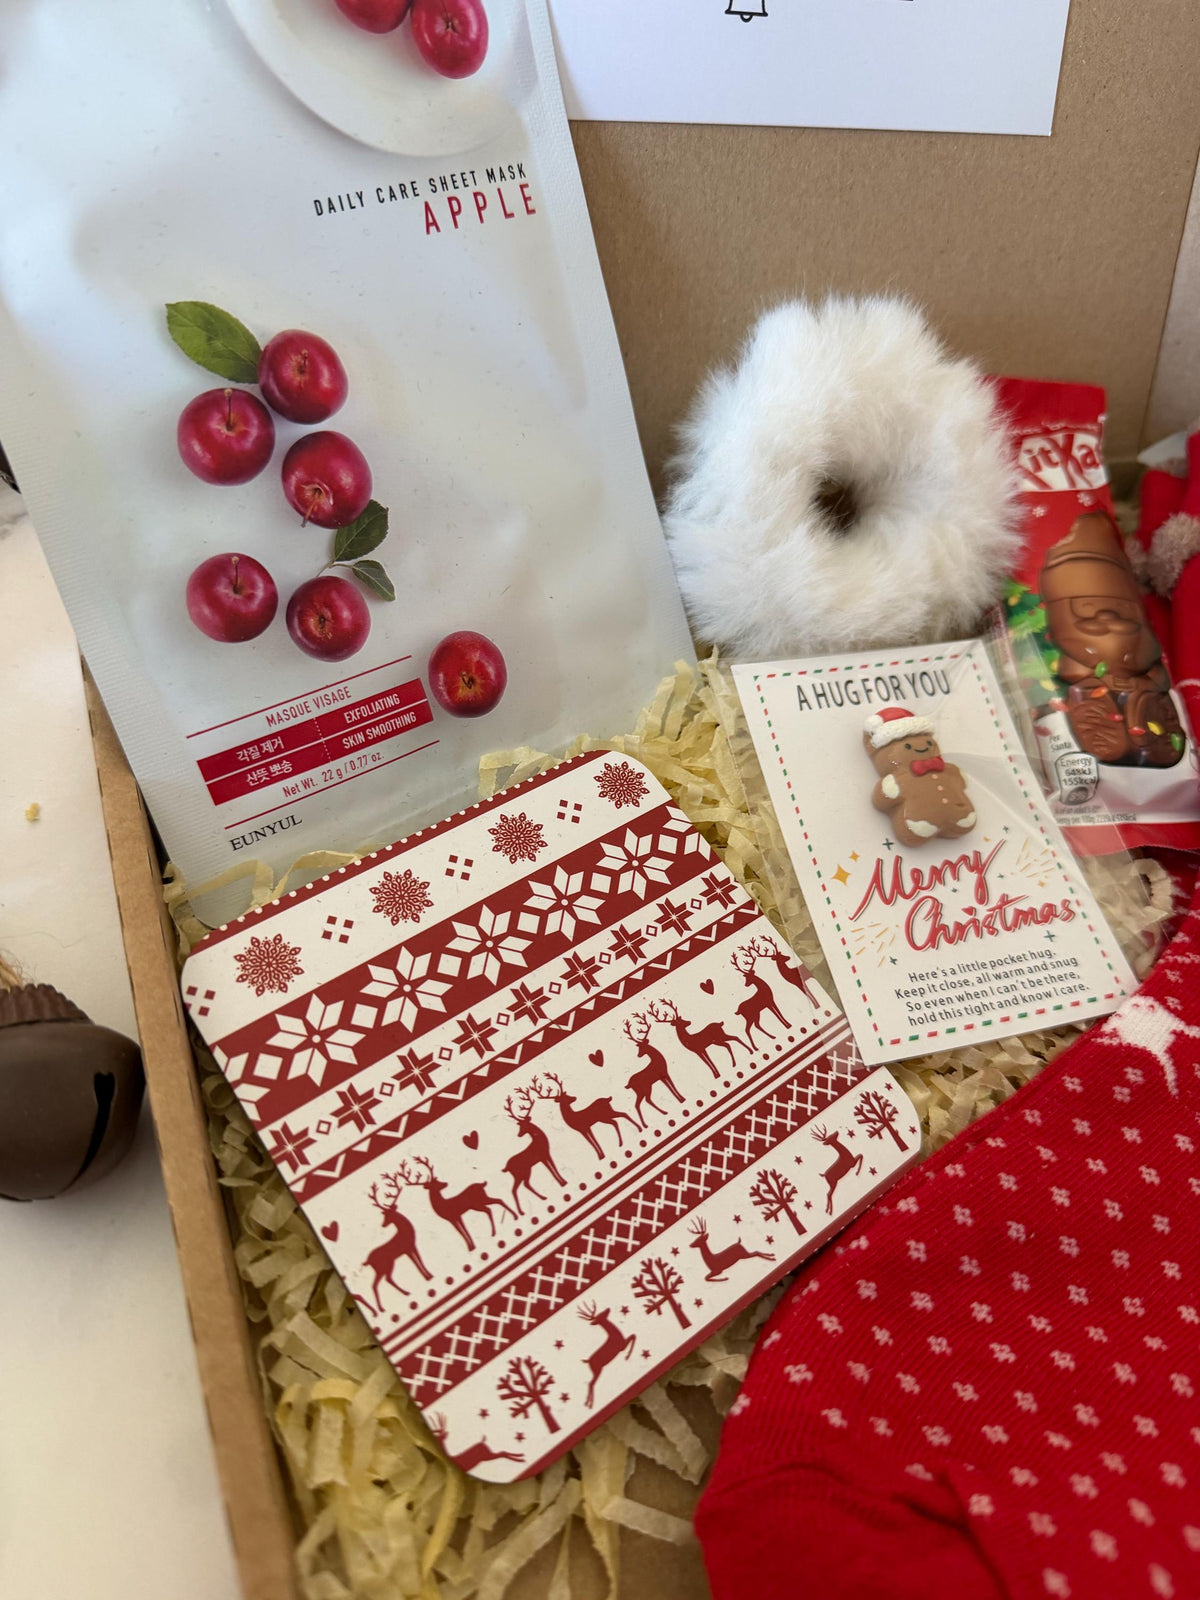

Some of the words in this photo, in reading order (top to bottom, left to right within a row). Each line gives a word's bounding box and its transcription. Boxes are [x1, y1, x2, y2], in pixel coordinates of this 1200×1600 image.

[313, 190, 366, 216] DAILY
[376, 180, 420, 204] CARE
[428, 170, 478, 193] SHEET
[485, 162, 527, 184] MASK
[423, 182, 537, 236] APPLE
[265, 701, 312, 727] MASQUE
[312, 686, 352, 709] VISAGE
[343, 693, 400, 724] EXFOLIATING
[796, 684, 812, 711] A
[811, 679, 861, 709] HUG
[861, 674, 906, 704] FOR
[904, 669, 951, 698] YOU
[236, 745, 261, 762] 각질
[260, 736, 285, 753] 제거
[342, 731, 366, 749] SKIN
[365, 711, 417, 740] SMOOTHING
[246, 767, 270, 786] 산뜻
[269, 760, 293, 777] 뽀송
[282, 783, 301, 797] Net
[301, 777, 318, 790] Wt.
[321, 769, 334, 782] 22
[336, 768, 343, 779] g
[349, 754, 368, 771] 0.77
[371, 752, 385, 762] oz.
[1060, 757, 1092, 767] Energy
[229, 815, 303, 851] EUNYUL
[848, 838, 1007, 922] Merry
[904, 893, 1077, 952] Christmas
[894, 987, 926, 999] Keep
[926, 983, 938, 993] it
[939, 978, 974, 991] close,
[976, 972, 991, 984] all
[992, 968, 1025, 981] warm
[1027, 961, 1049, 975] and
[1049, 957, 1079, 969] snug
[908, 966, 947, 983] Here's
[949, 967, 957, 975] a
[957, 960, 988, 974] little
[988, 952, 1030, 970] pocket
[1028, 948, 1056, 960] hug.
[905, 1001, 922, 1012] So
[924, 996, 954, 1009] even
[955, 989, 989, 1003] when
[989, 986, 995, 996] I
[996, 979, 1028, 995] can't
[1027, 978, 1044, 988] be
[1043, 971, 1080, 984] there,
[907, 1011, 938, 1026] hold
[938, 1008, 963, 1020] this
[963, 1001, 996, 1016] tight
[996, 995, 1020, 1009] and
[1019, 990, 1053, 1003] know
[1052, 987, 1059, 996] I
[1060, 983, 1090, 995] care.
